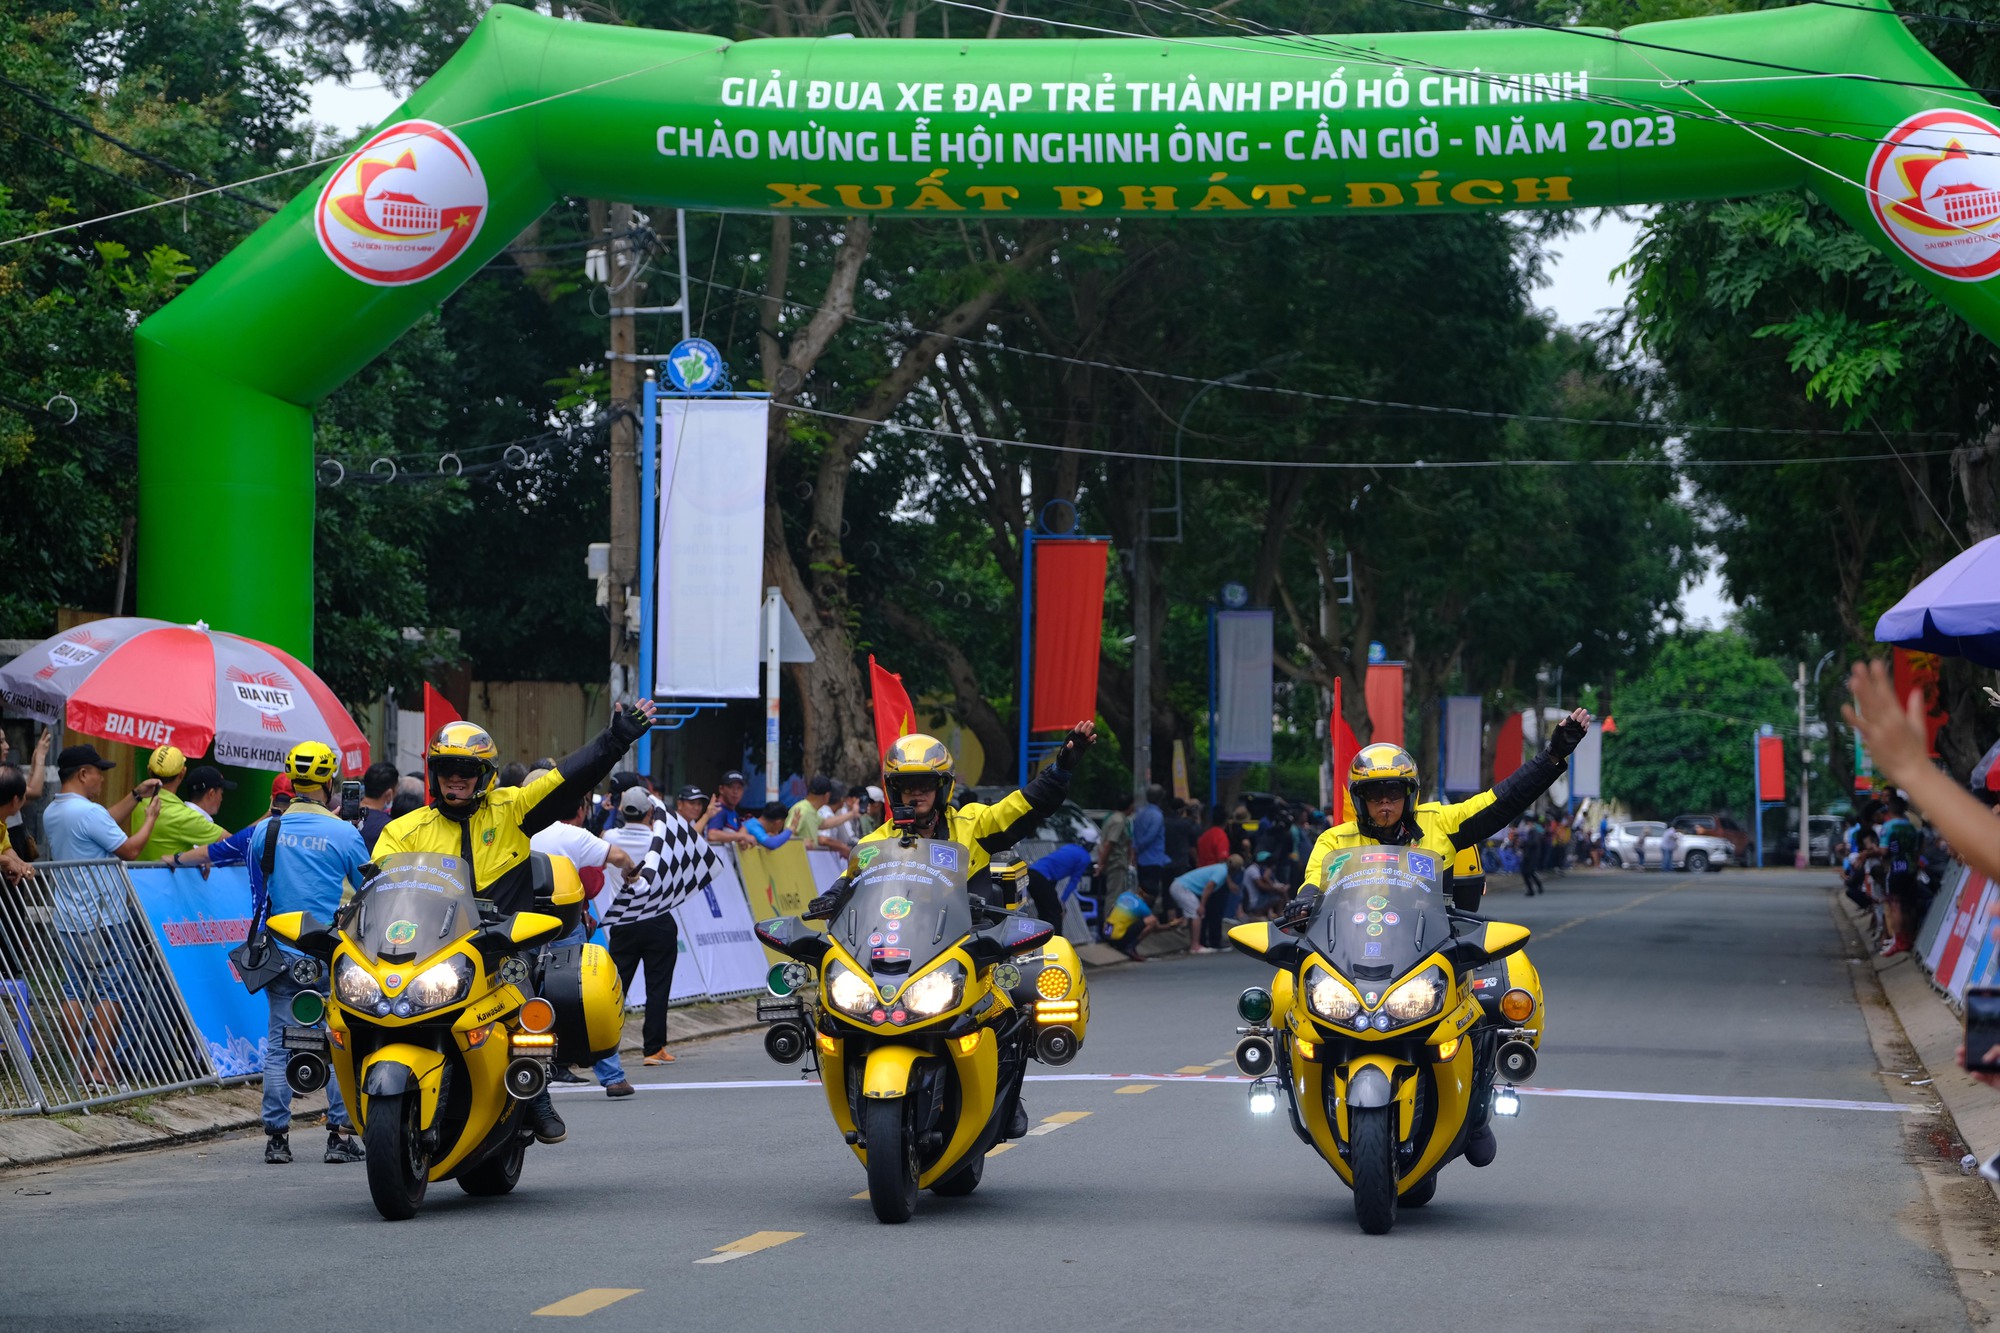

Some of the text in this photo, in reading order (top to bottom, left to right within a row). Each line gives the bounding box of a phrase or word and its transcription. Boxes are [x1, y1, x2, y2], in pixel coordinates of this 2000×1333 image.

[721, 65, 1588, 119] GIẢI ĐUA XE ĐẠP TRẺ THÀNH PHỐ HỒ CHÍ MINH
[656, 119, 759, 160] CHÀO
[768, 121, 879, 163] MỪNG
[888, 116, 931, 163] LỄ
[940, 124, 1003, 169] HỘI
[1013, 131, 1159, 164] NGHINH
[1168, 122, 1249, 163] ÔNG
[1284, 113, 1368, 161] CẦN
[1377, 116, 1440, 159] GIỜ
[1475, 115, 1567, 156] NĂM
[1586, 115, 1676, 151] 2023
[766, 168, 1019, 212] XUẤT
[238, 685, 289, 708] BIA VIỆT
[104, 713, 175, 746] BIA VIỆT
[250, 747, 286, 764] KHOÁI
[277, 830, 328, 852] ÁO CHÍ
[476, 999, 506, 1023] Kawasaki
